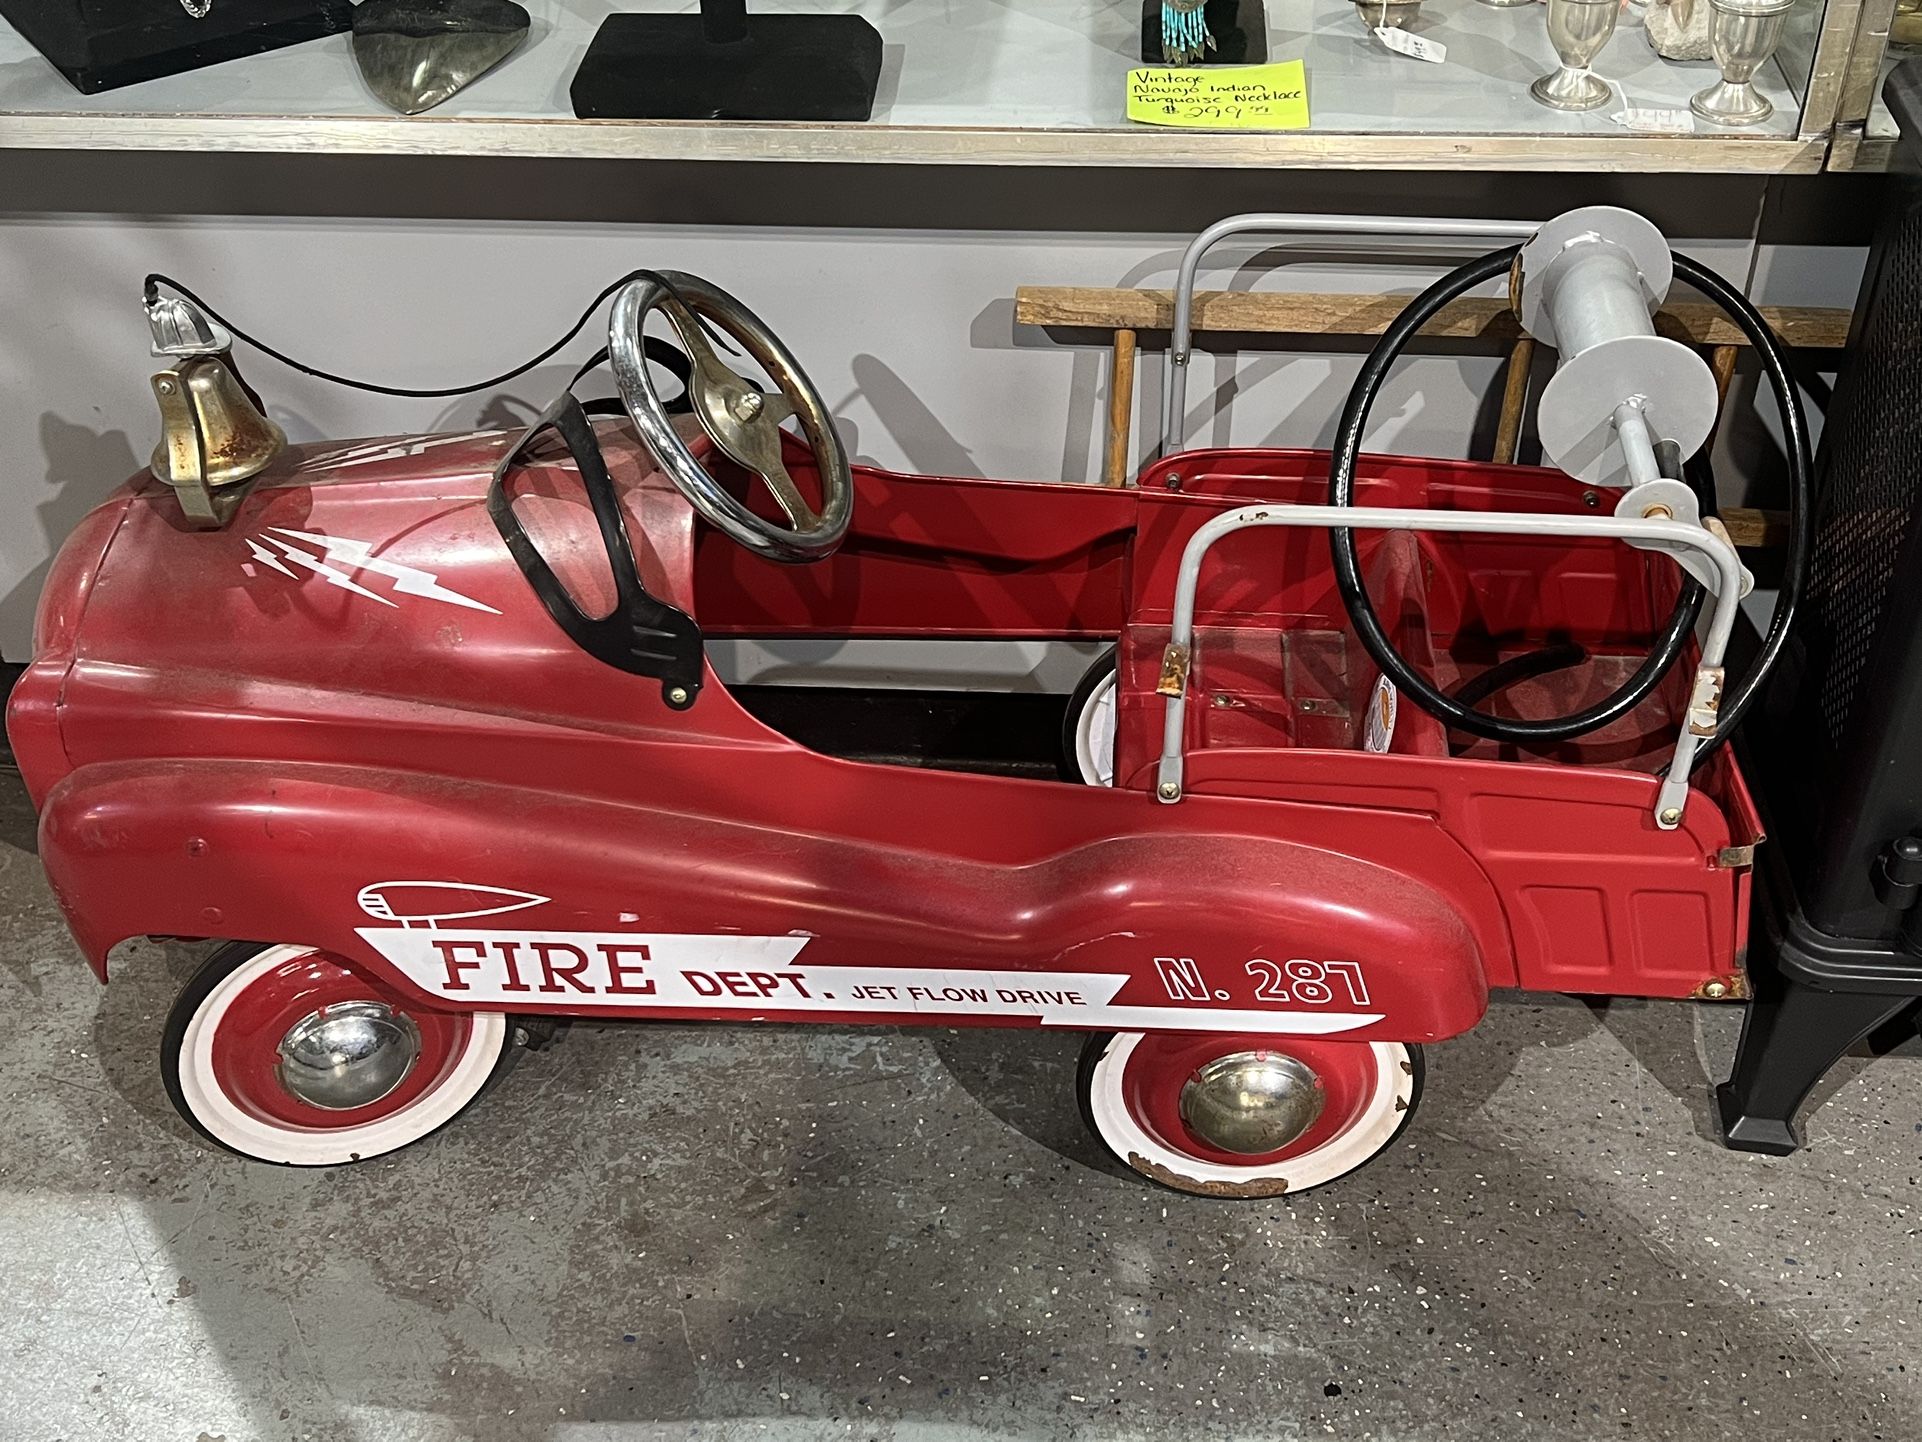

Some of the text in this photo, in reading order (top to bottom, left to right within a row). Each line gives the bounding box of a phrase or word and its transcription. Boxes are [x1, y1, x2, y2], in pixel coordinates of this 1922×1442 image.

[1135, 70, 1205, 87] Vintage
[1132, 90, 1301, 106] Turquoise Necklace
[1133, 84, 1266, 97] Navajo Indian
[432, 939, 836, 1000] FIRE DEPT.
[1153, 957, 1372, 1006] N. 287
[851, 984, 1088, 1006] JET FLOW DRIVE
